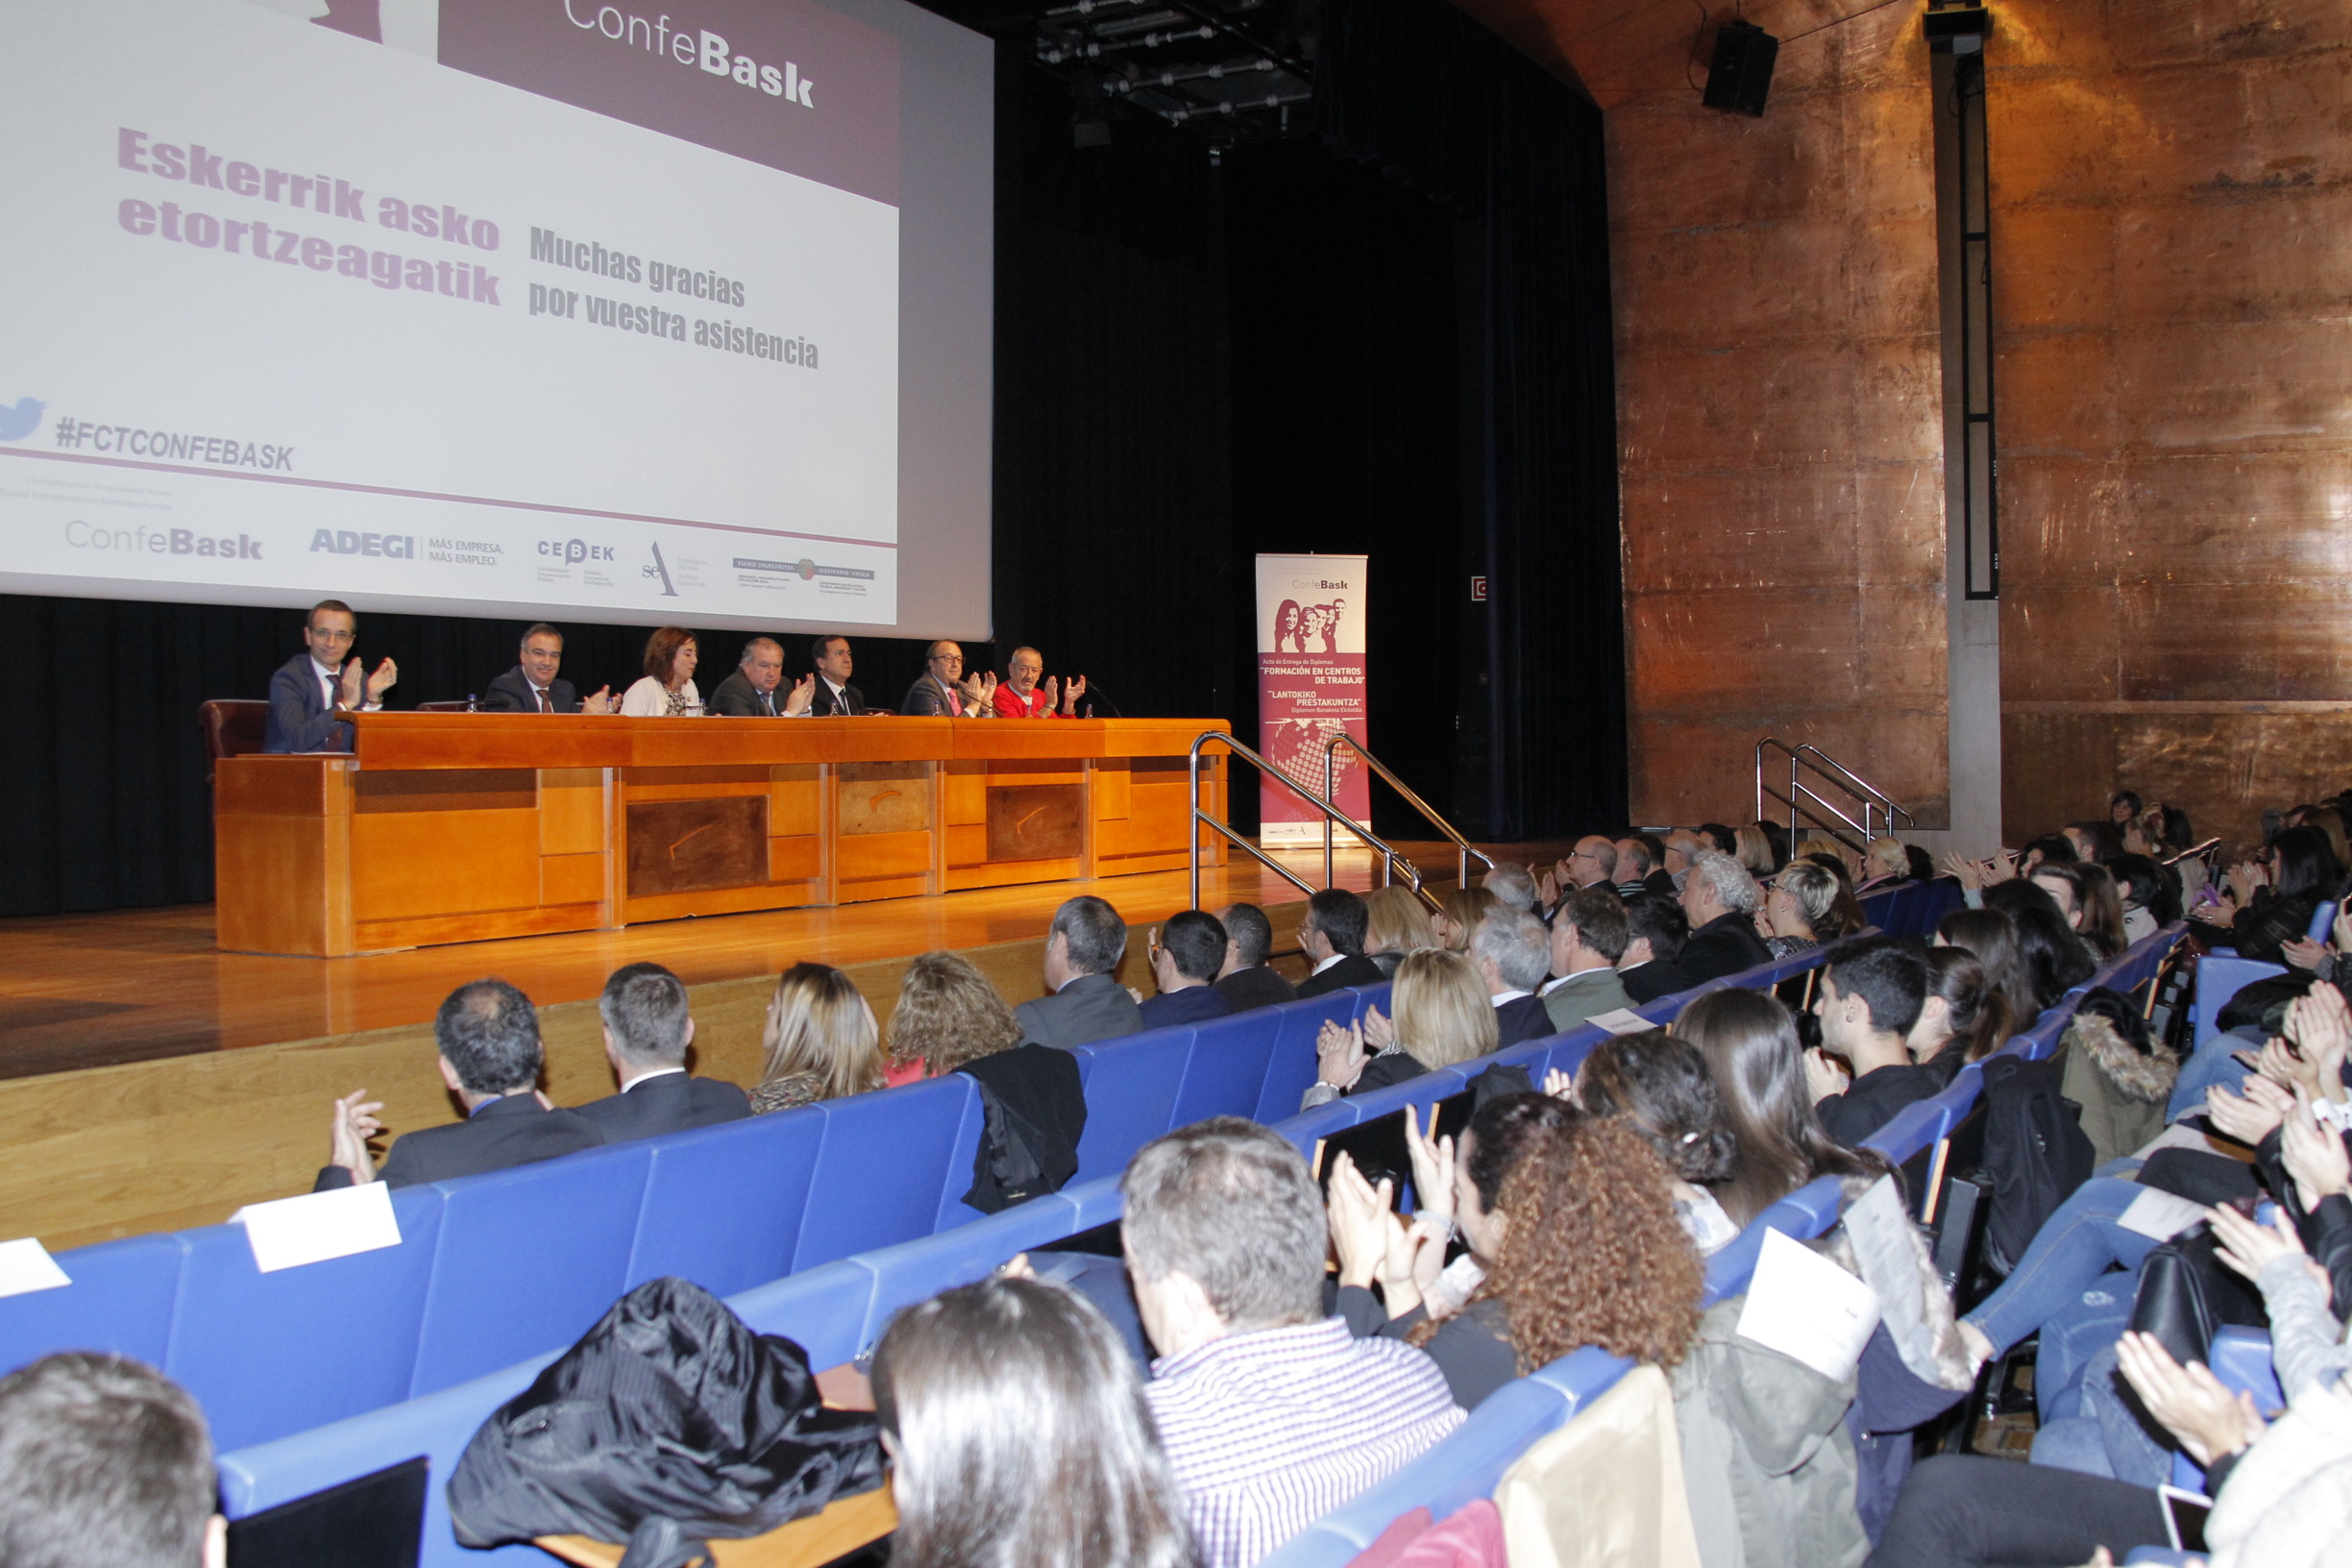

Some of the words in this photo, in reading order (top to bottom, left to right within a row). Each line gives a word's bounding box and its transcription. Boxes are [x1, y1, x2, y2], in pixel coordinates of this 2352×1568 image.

[564, 0, 815, 110] ConfeBask
[118, 127, 367, 223] Eskerrik
[378, 196, 501, 252] asko
[118, 198, 502, 307] etortzeagatik
[529, 226, 642, 284] Muchas
[649, 257, 746, 308] gracias
[528, 282, 578, 320] por
[585, 295, 687, 342] vuestra
[694, 318, 820, 370] asistencia
[56, 416, 295, 472] #FCTCONFEBASK
[64, 520, 263, 560] ConfeBask
[309, 528, 414, 560] ADEGI
[429, 537, 453, 550] MÁS
[455, 540, 505, 554] EMPRESA.
[429, 551, 453, 564] MÁS
[455, 553, 498, 567] EMPLEO.
[537, 538, 615, 564] CEBEK
[1292, 578, 1349, 590] ConfeBask
[1312, 667, 1323, 675] EN
[1324, 667, 1361, 675] CENTROS
